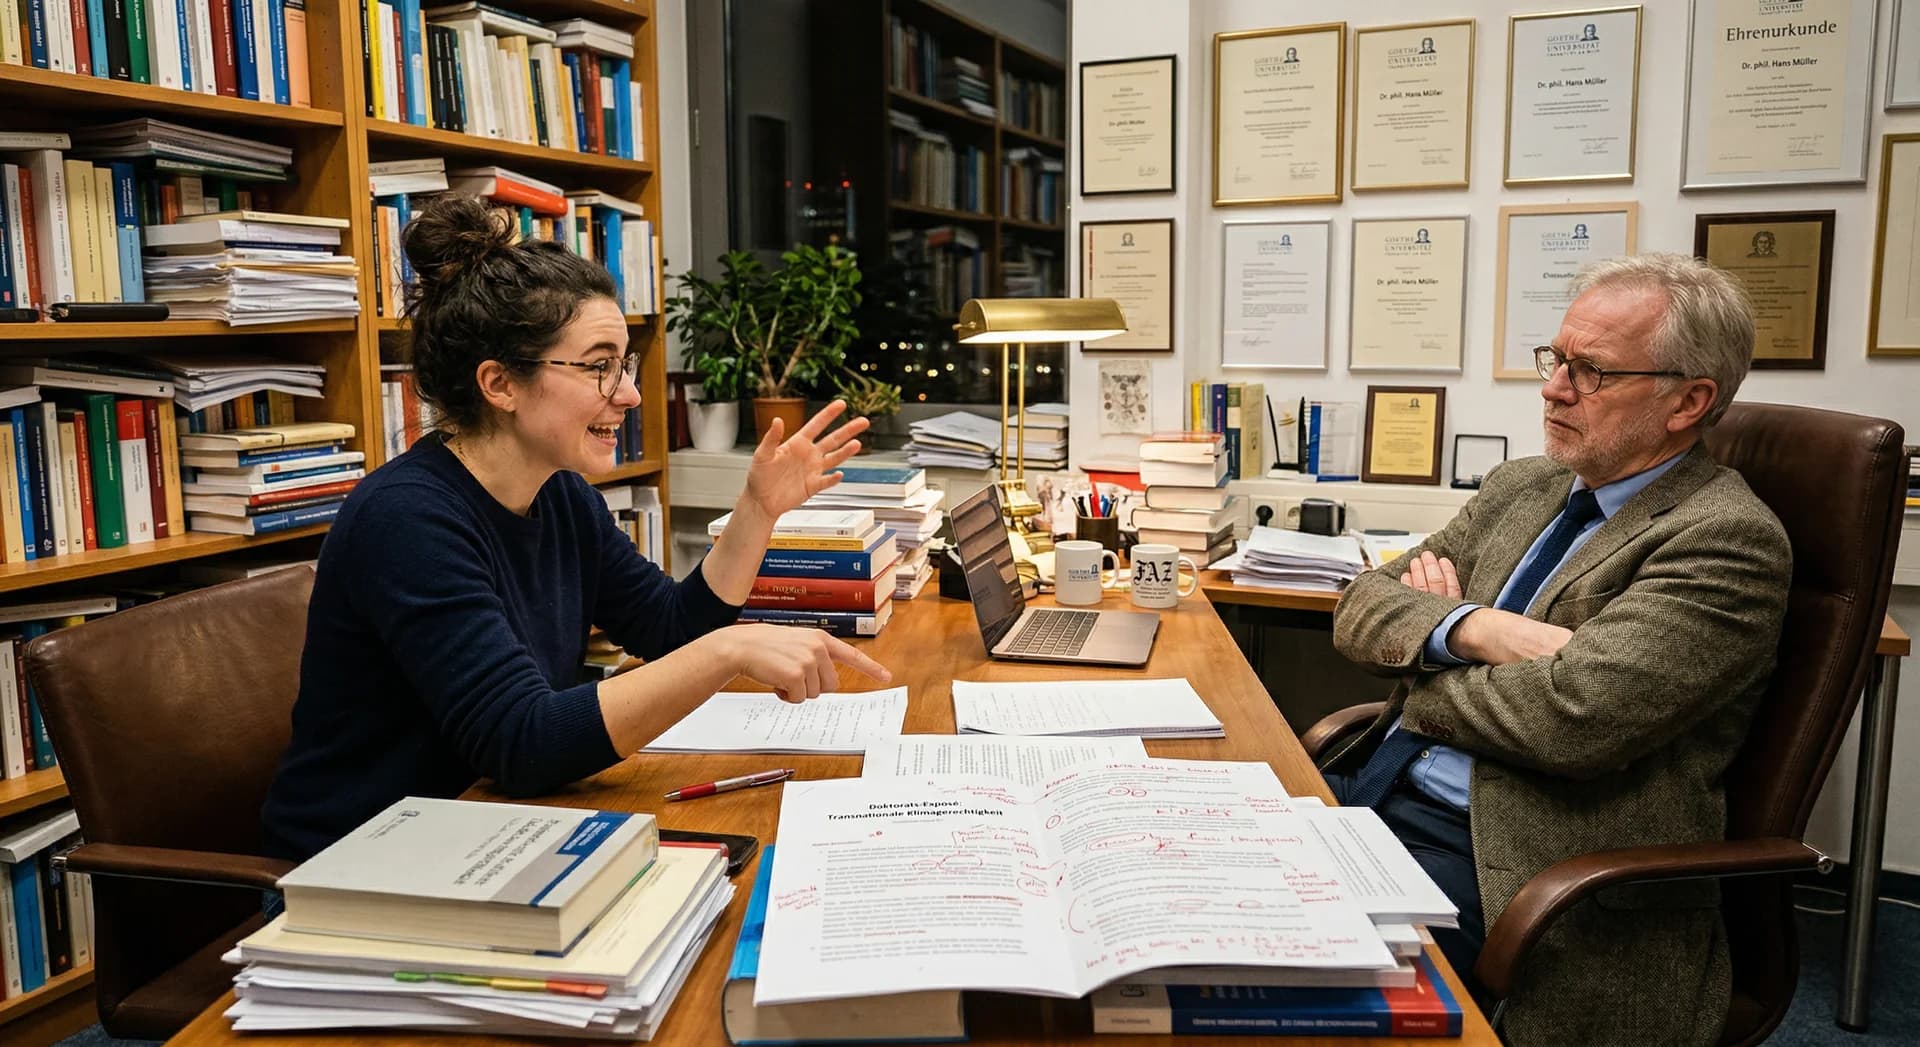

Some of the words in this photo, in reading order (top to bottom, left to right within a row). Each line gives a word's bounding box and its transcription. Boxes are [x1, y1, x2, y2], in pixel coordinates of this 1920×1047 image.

[1726, 20, 1837, 41] Ehrenurkunde
[1741, 62, 1753, 70] Dr.
[1754, 60, 1769, 70] phil.
[1772, 59, 1791, 68] Hans
[1793, 57, 1818, 66] Müller
[1549, 80, 1562, 89] phil.
[1565, 79, 1583, 87] Hans
[1585, 77, 1607, 85] Müller
[1423, 88, 1443, 97] Müller
[1134, 559, 1173, 586] FAZ
[869, 800, 962, 811] Doktorats-Exposé:
[827, 810, 905, 821] Transnationale
[907, 807, 1003, 818] Klimagerechtigkeit
